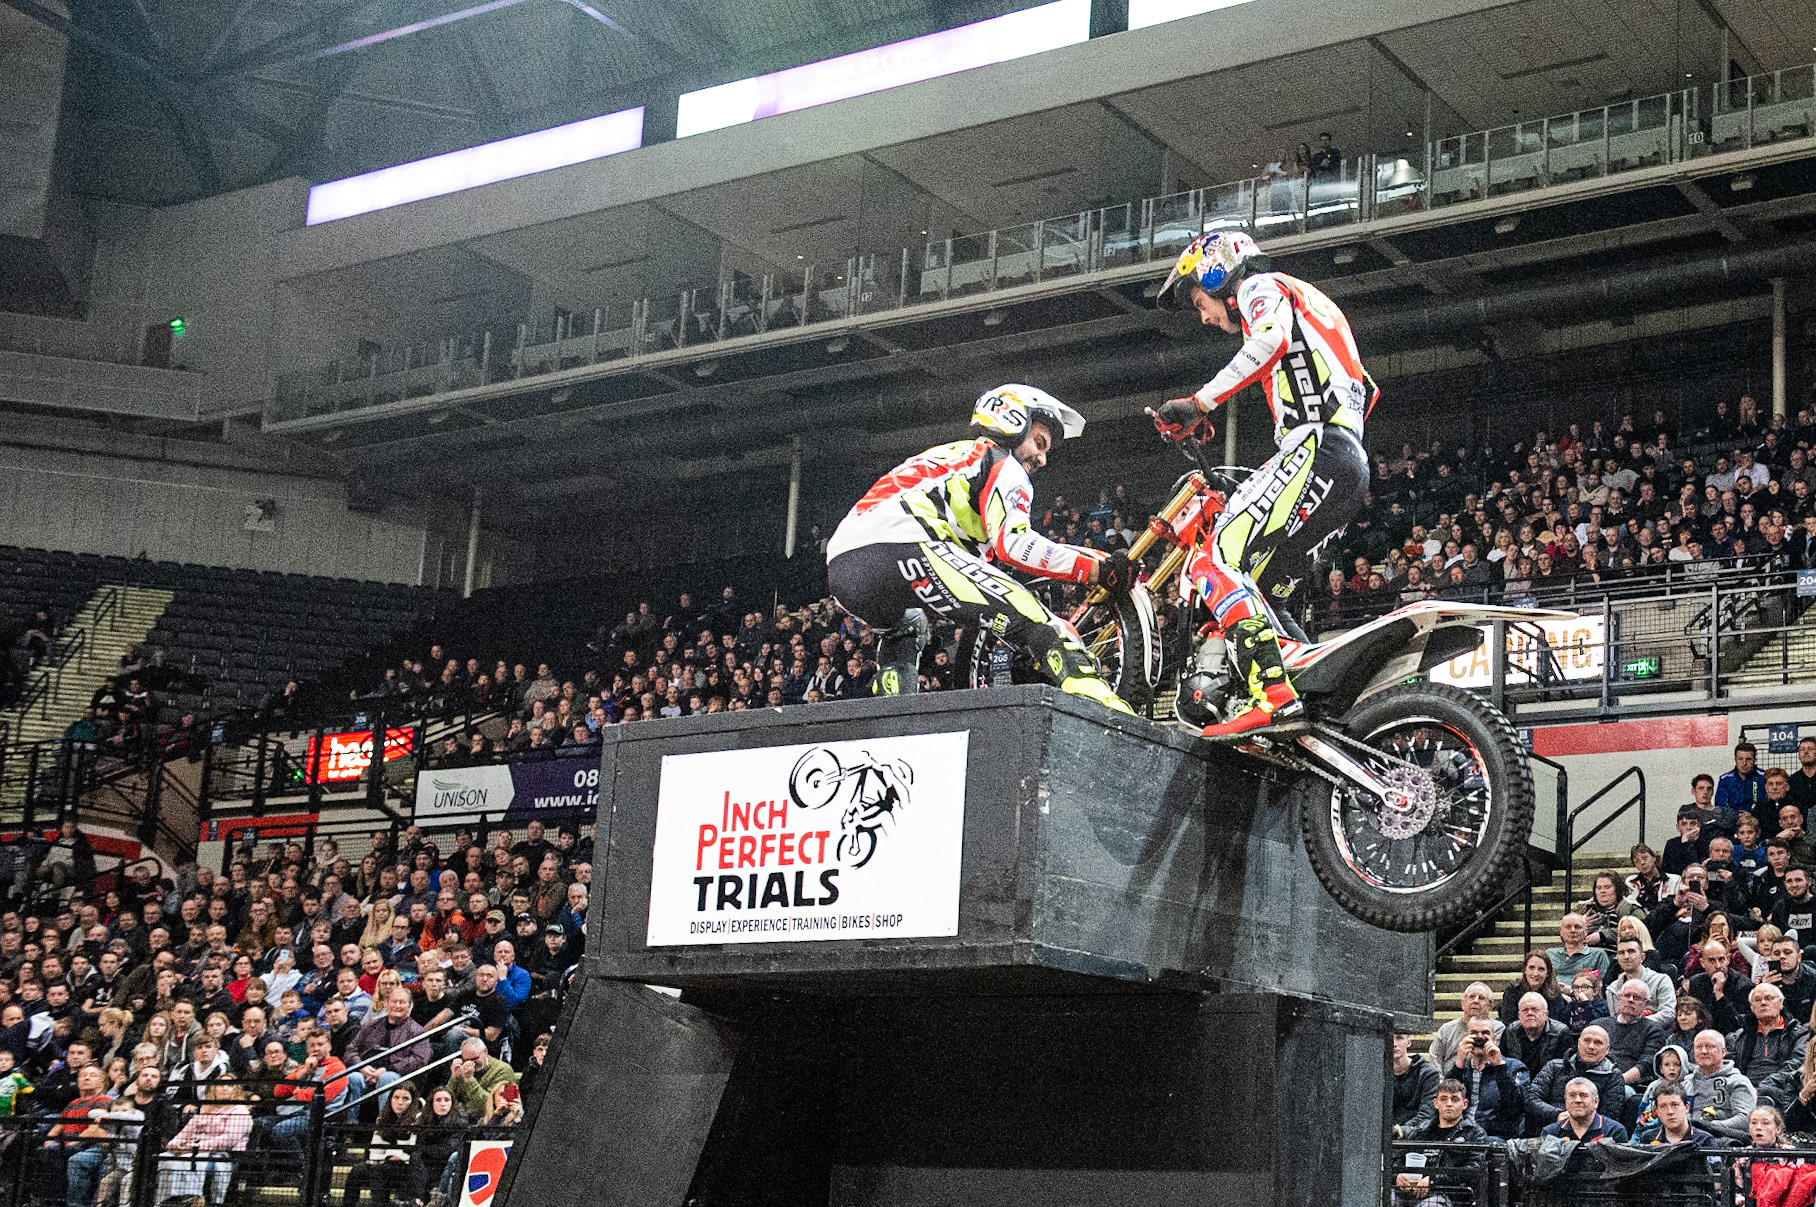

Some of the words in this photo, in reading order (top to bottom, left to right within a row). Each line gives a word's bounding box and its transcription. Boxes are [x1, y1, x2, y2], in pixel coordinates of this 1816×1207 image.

[1286, 341, 1322, 422] heb
[1247, 446, 1310, 523] hebo
[1288, 476, 1334, 538] TRS
[897, 557, 952, 616] TRS
[1772, 731, 1794, 741] 104
[434, 788, 488, 808] UNISON
[574, 769, 599, 788] 08
[722, 791, 788, 832] INCH
[696, 824, 831, 870] PERFECT
[693, 869, 840, 912] TRIALS
